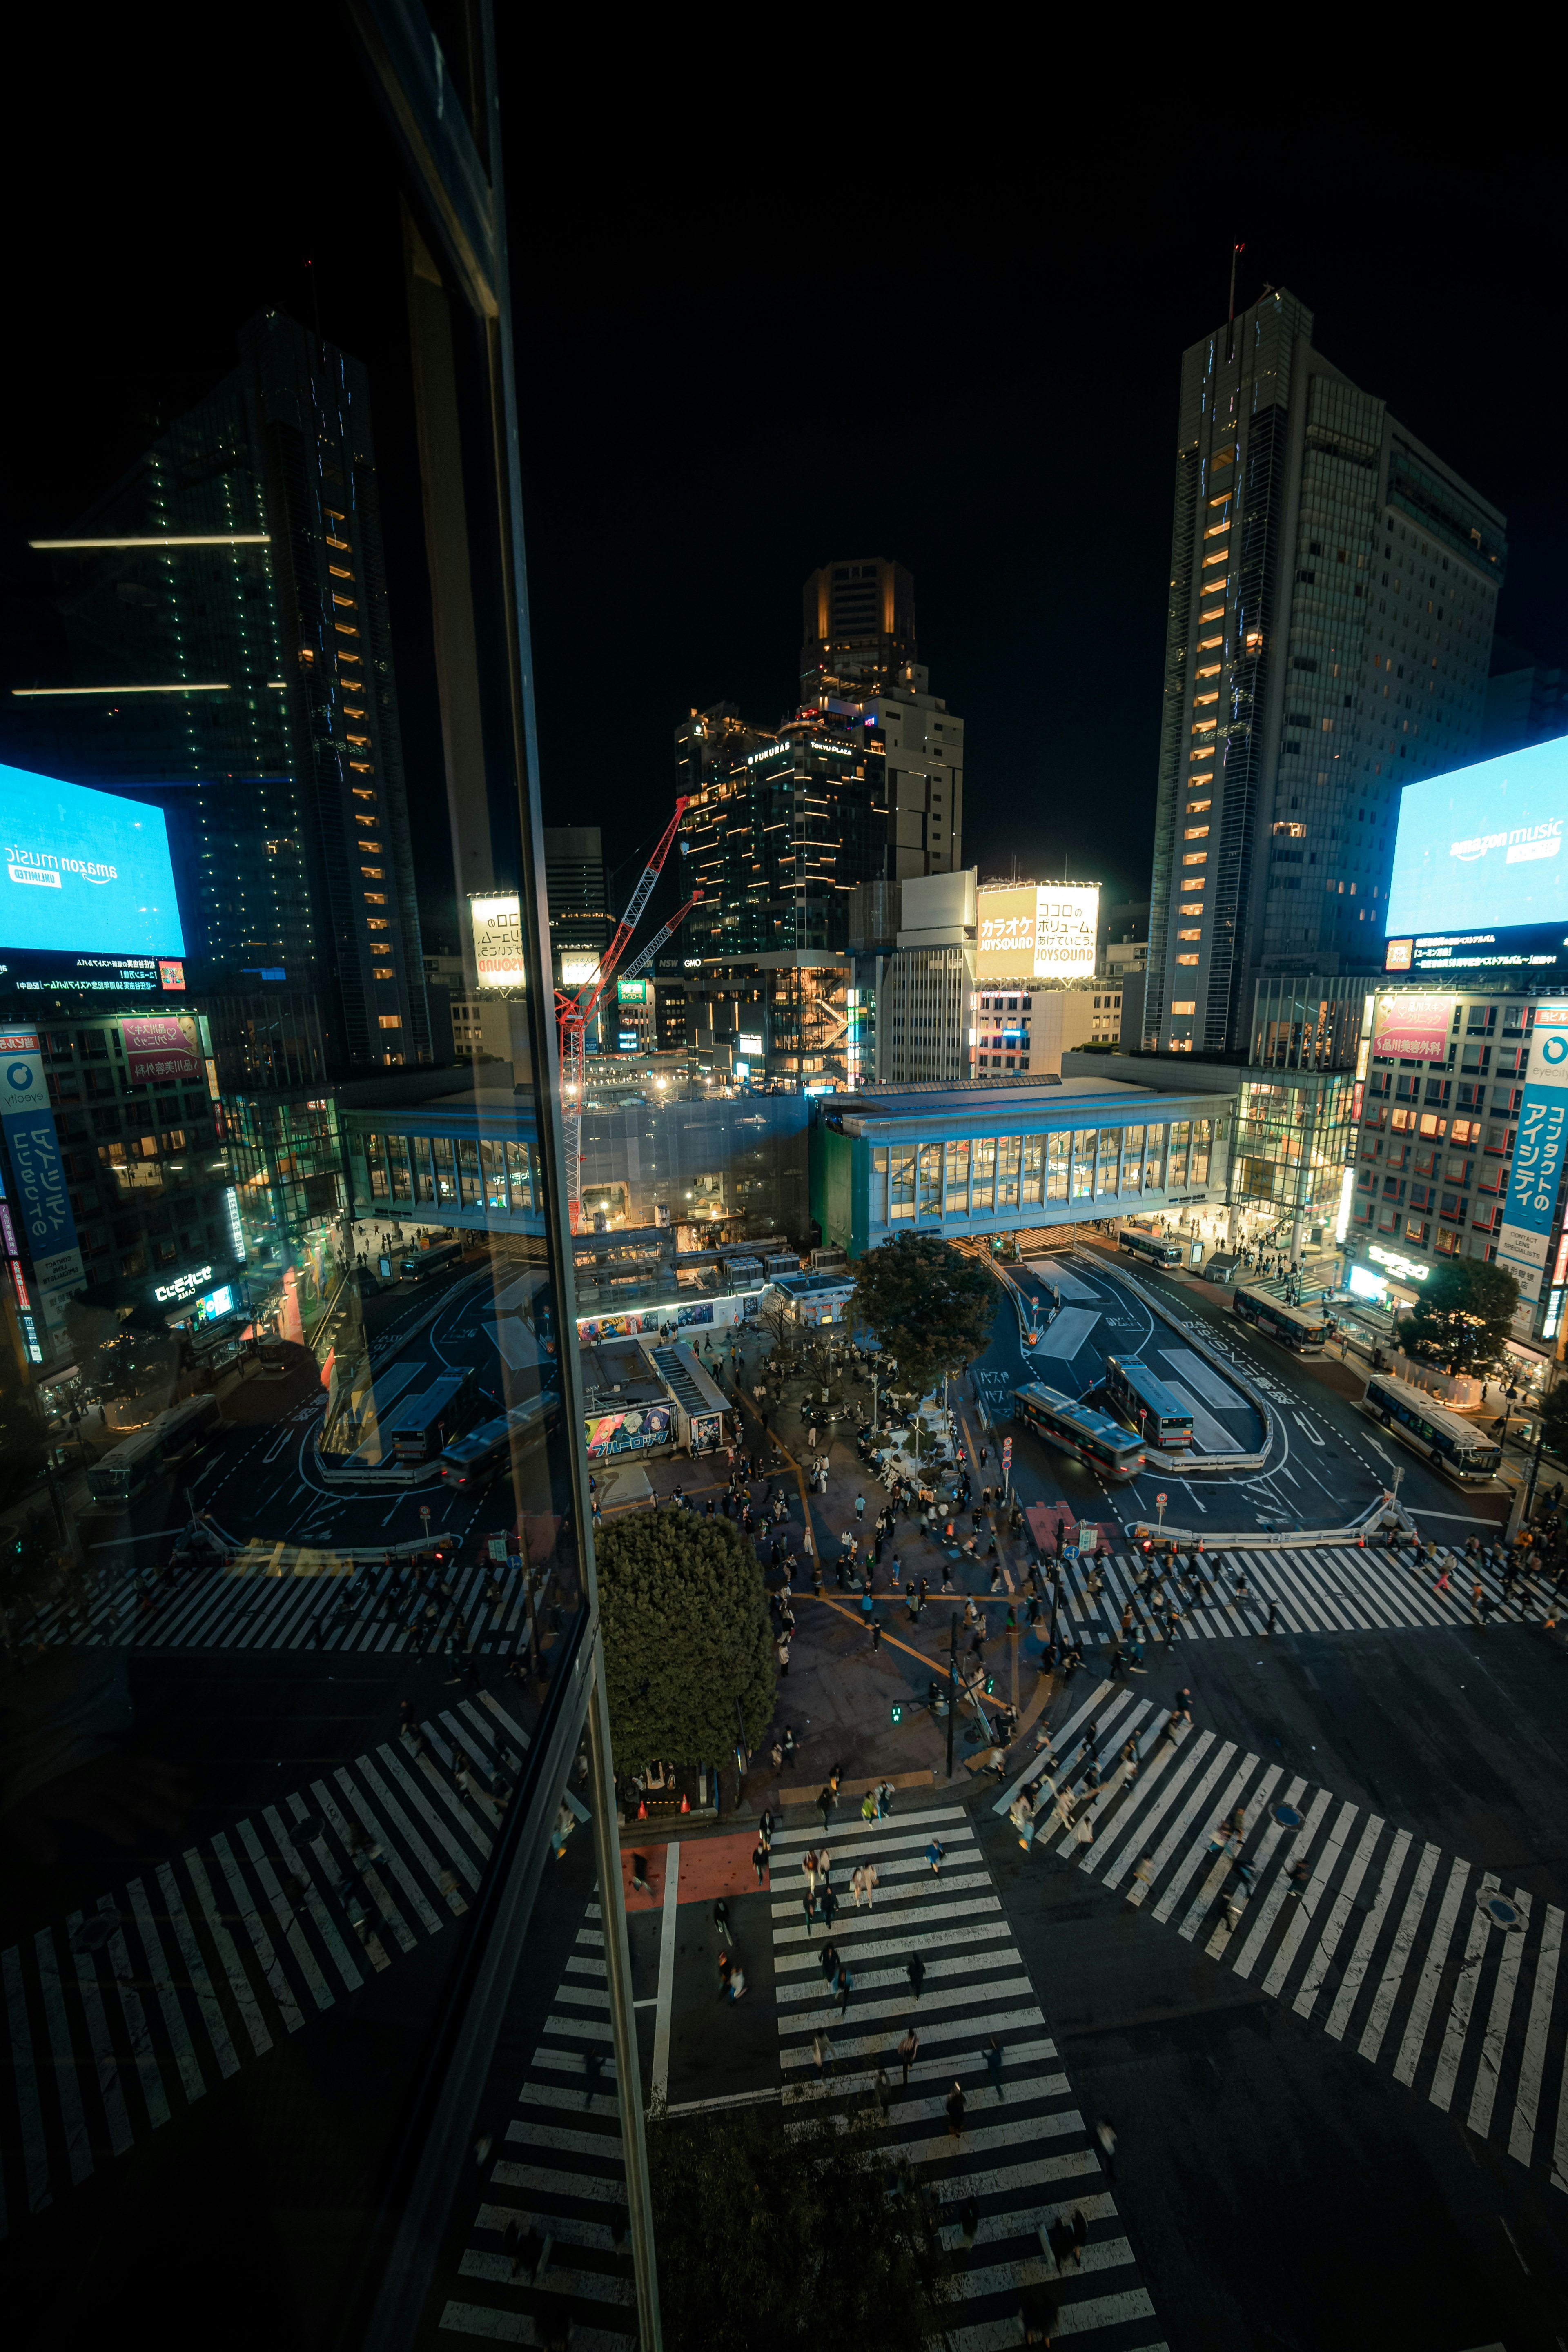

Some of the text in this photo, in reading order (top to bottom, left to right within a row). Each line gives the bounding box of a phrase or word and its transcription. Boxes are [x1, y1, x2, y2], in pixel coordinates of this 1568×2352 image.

[754, 742, 791, 763] FUKURAS
[811, 742, 852, 755] TOKYU PLAZA
[1450, 832, 1507, 856] amazon
[1509, 817, 1564, 844] music
[1038, 903, 1082, 918] ココロの
[981, 916, 1033, 938] カラオケ
[1038, 920, 1093, 934] ボリューム、
[980, 936, 1033, 951] JOYSOUND
[1037, 935, 1094, 947] あげていこう。
[1035, 949, 1093, 961] JOYSOUND
[684, 958, 701, 967] GMO
[1408, 1002, 1447, 1012] 品川スキン
[1406, 1014, 1441, 1025] クリニック
[1382, 1038, 1441, 1055] 品川美容外科
[1533, 1067, 1568, 1081] eyecity
[1514, 1103, 1547, 1206] アイシティ
[1533, 1106, 1565, 1211] コンタクトの
[1511, 1232, 1537, 1244] CONTACT
[1515, 1240, 1530, 1249] LENS
[1504, 1243, 1540, 1259] SPECIALISTS
[592, 1430, 669, 1457] ブルーロック
